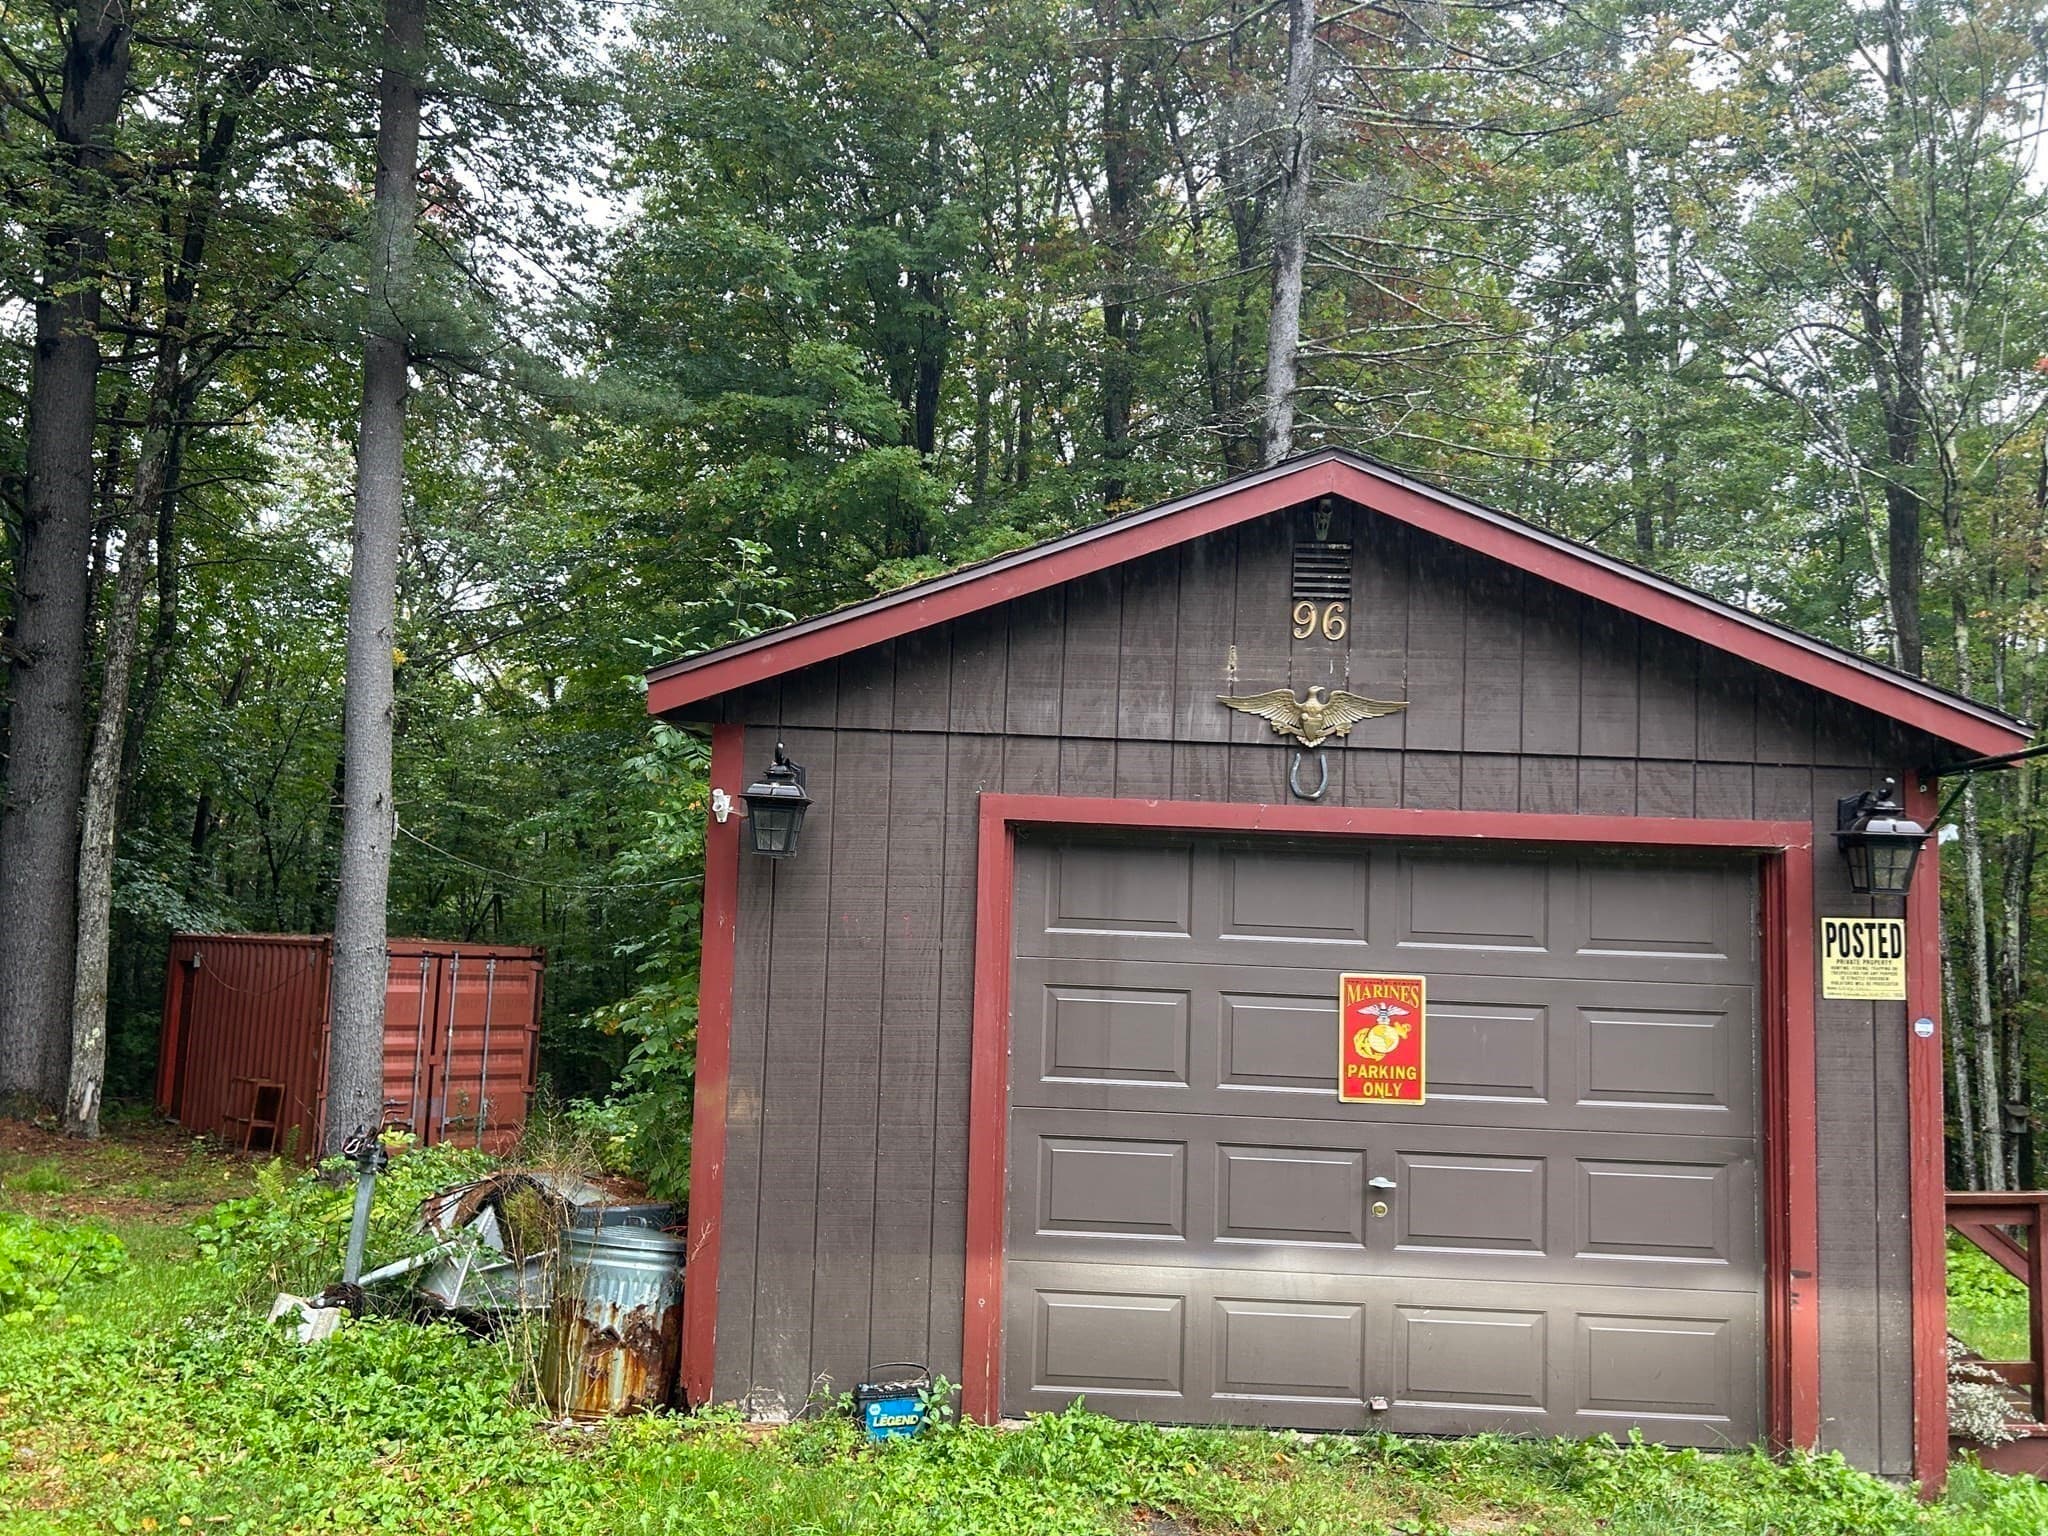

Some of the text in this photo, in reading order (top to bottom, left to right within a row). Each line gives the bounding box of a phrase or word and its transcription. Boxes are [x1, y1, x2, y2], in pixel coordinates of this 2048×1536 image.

[1292, 600, 1347, 641] 96
[1825, 922, 1902, 958] POSTED
[1346, 984, 1420, 1009] MARINES
[1347, 1064, 1417, 1080] PARKING
[1363, 1081, 1403, 1097] ONLY
[873, 1414, 919, 1427] LEGEND
